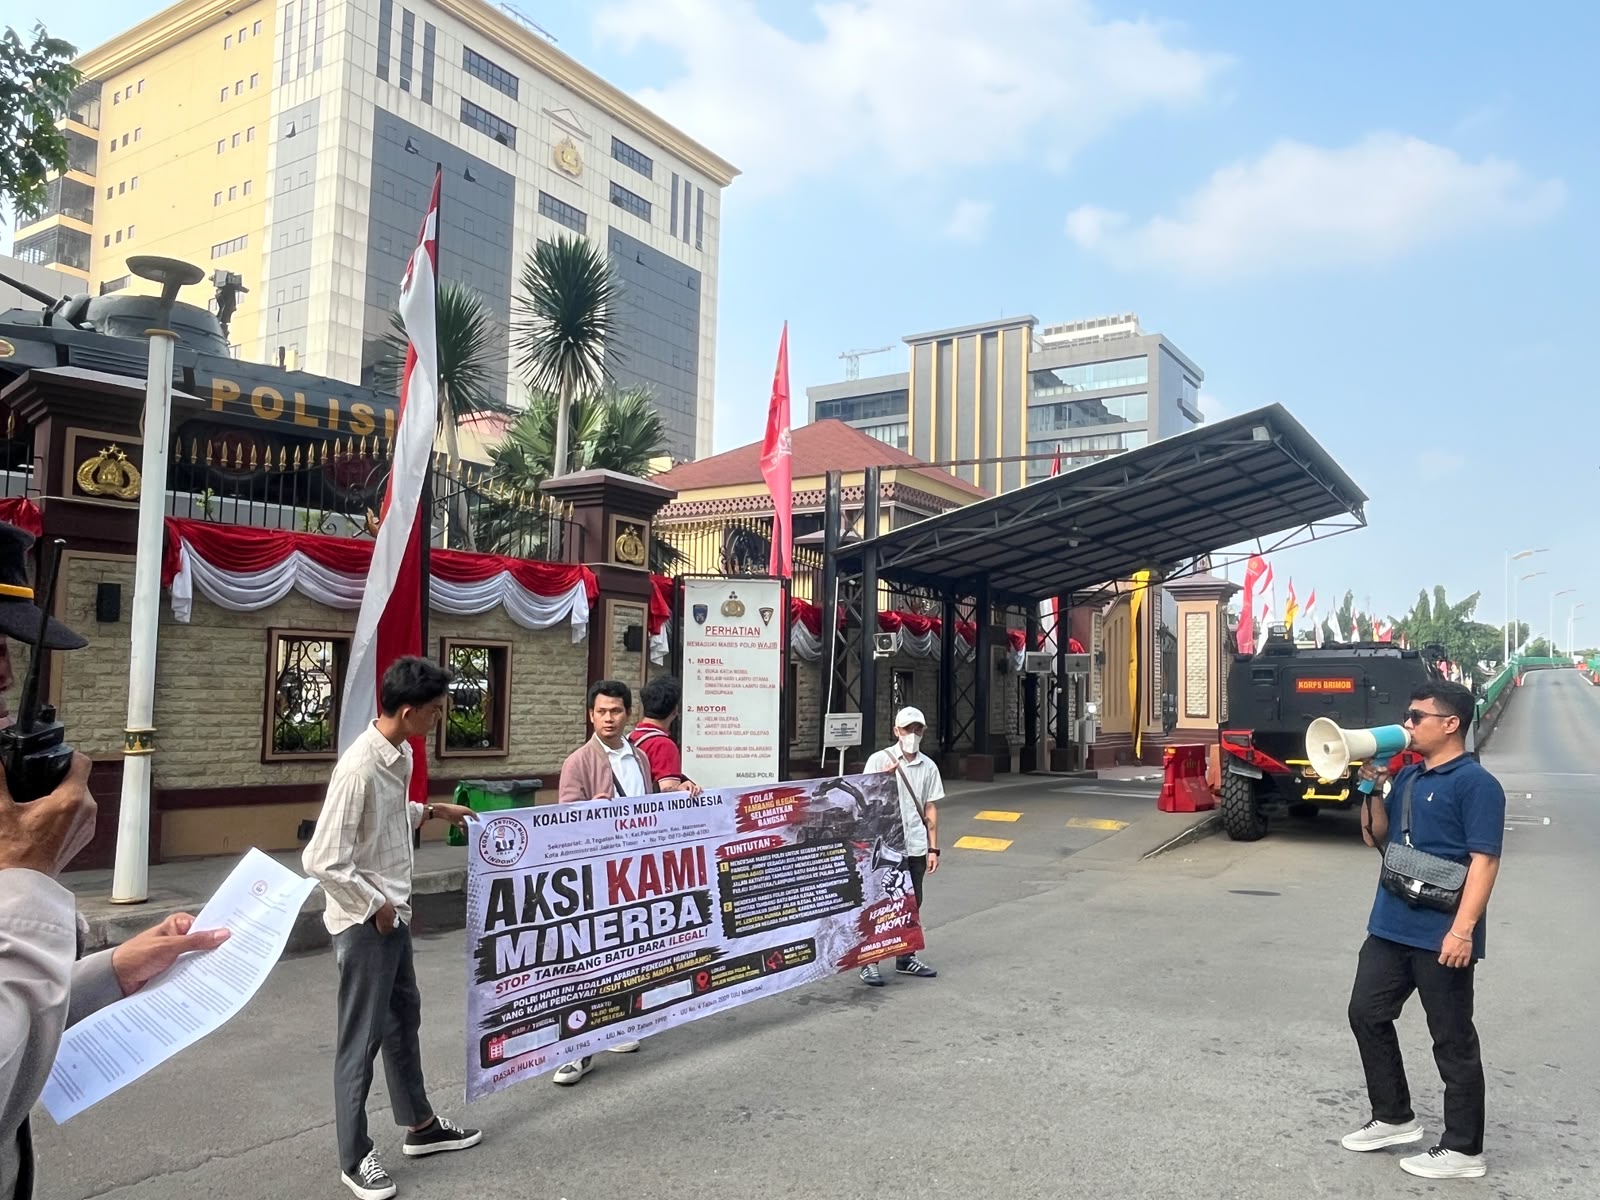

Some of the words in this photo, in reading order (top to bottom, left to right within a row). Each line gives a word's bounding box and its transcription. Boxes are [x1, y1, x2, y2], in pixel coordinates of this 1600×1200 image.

[212, 378, 394, 438] POLISI
[705, 626, 761, 637] PERHATIAN
[744, 800, 774, 813] TAMBANG
[749, 792, 774, 804] TOLAK
[534, 810, 581, 827] KOALISI
[586, 804, 630, 820] AKTIVIS
[634, 802, 664, 815] MUDA
[668, 795, 723, 810] INDONESIA
[750, 805, 793, 820] SELAMATKAN
[758, 814, 787, 827] BANGSA!
[615, 814, 658, 832] (KAMI)
[725, 838, 770, 855] TUNTUTAN
[484, 864, 594, 932] AKSI
[606, 845, 708, 906] KAMI
[869, 900, 904, 920] KEADILAN
[876, 911, 896, 924] UNTUK
[874, 913, 912, 934] RAKYAT!
[496, 896, 703, 974] MINERBA
[860, 942, 881, 952] AHMAD
[496, 974, 530, 993] STOP
[535, 956, 601, 980] TAMBANG
[605, 948, 634, 964] BATU
[638, 940, 665, 954] BARA
[669, 928, 708, 946] ILEGAL!
[501, 1009, 524, 1022] YANG
[526, 1001, 548, 1014] KAMI
[600, 981, 621, 994] USUT
[622, 973, 651, 987] TUNTAS
[652, 966, 674, 977] MAFIA
[676, 954, 712, 970] TAMBANG!
[514, 996, 538, 1008] POLRI
[540, 988, 560, 1000] HARI
[562, 984, 574, 994] INI
[577, 976, 612, 990] ADALAH
[613, 967, 640, 981] APARAT
[641, 958, 672, 973] PENEGAK
[493, 1066, 515, 1082] DASAR
[518, 1056, 546, 1071] HUKUM
